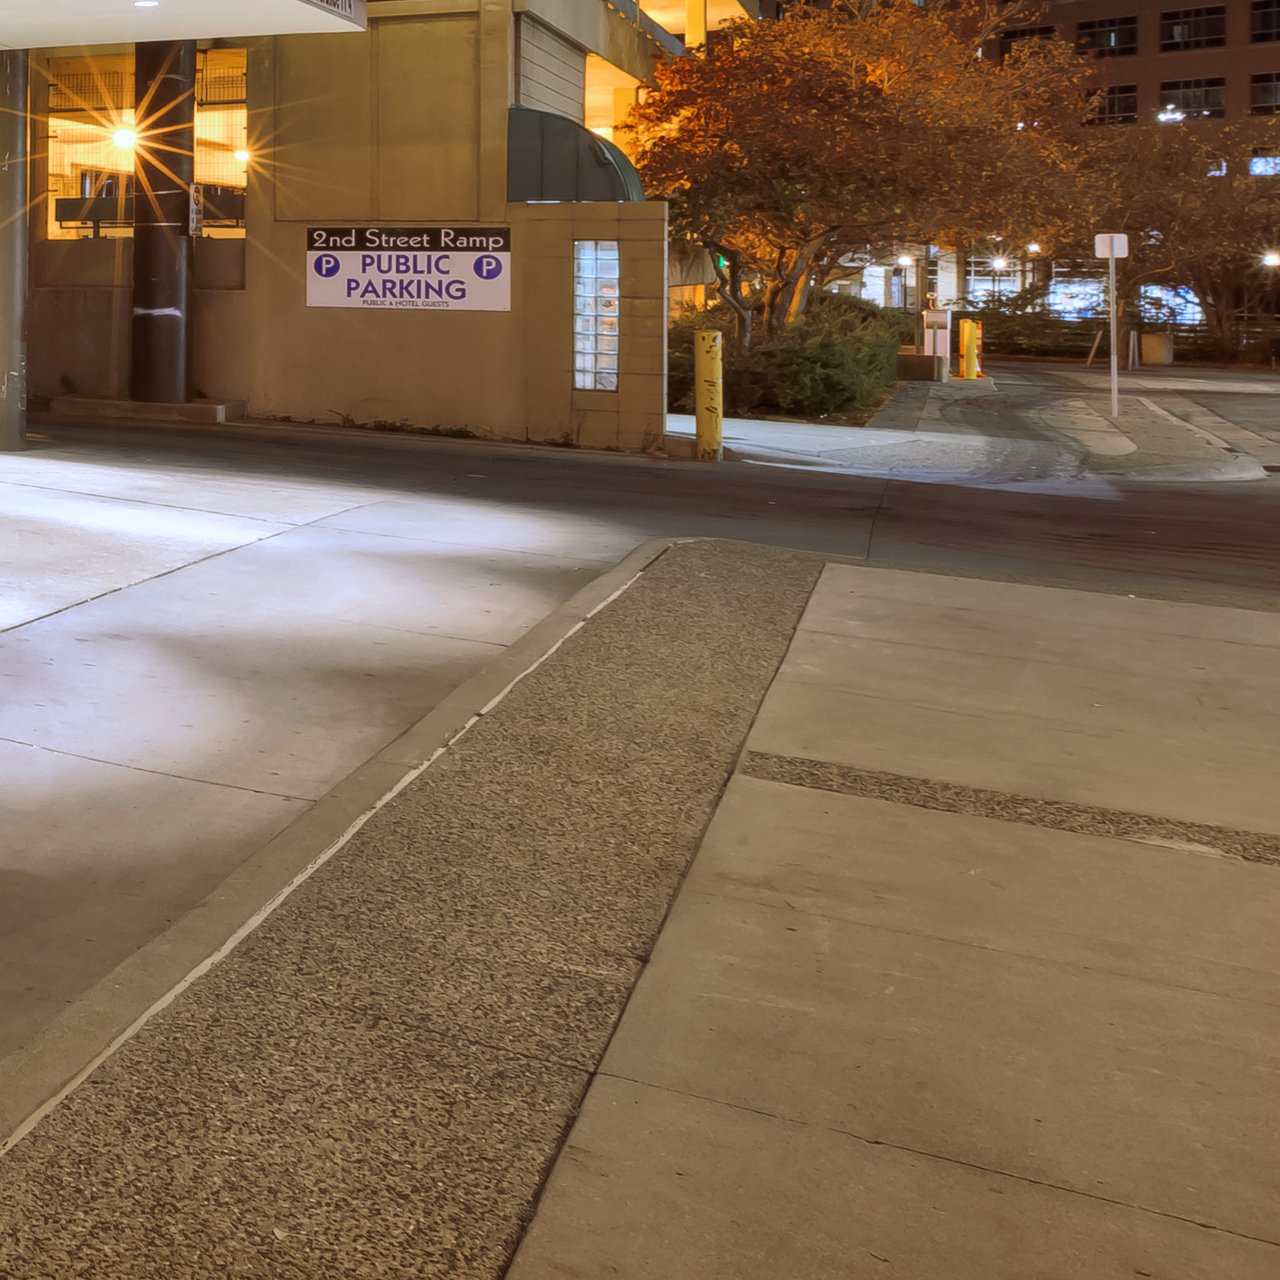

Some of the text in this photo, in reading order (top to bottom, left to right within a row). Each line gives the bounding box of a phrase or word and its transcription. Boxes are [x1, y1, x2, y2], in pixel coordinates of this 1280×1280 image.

[313, 228, 504, 251] 2nd Street Ramp
[321, 257, 335, 274] P
[361, 254, 450, 275] PUBLIC
[482, 257, 497, 277] P
[346, 278, 466, 300] PARKING
[422, 300, 450, 308] GUESTS
